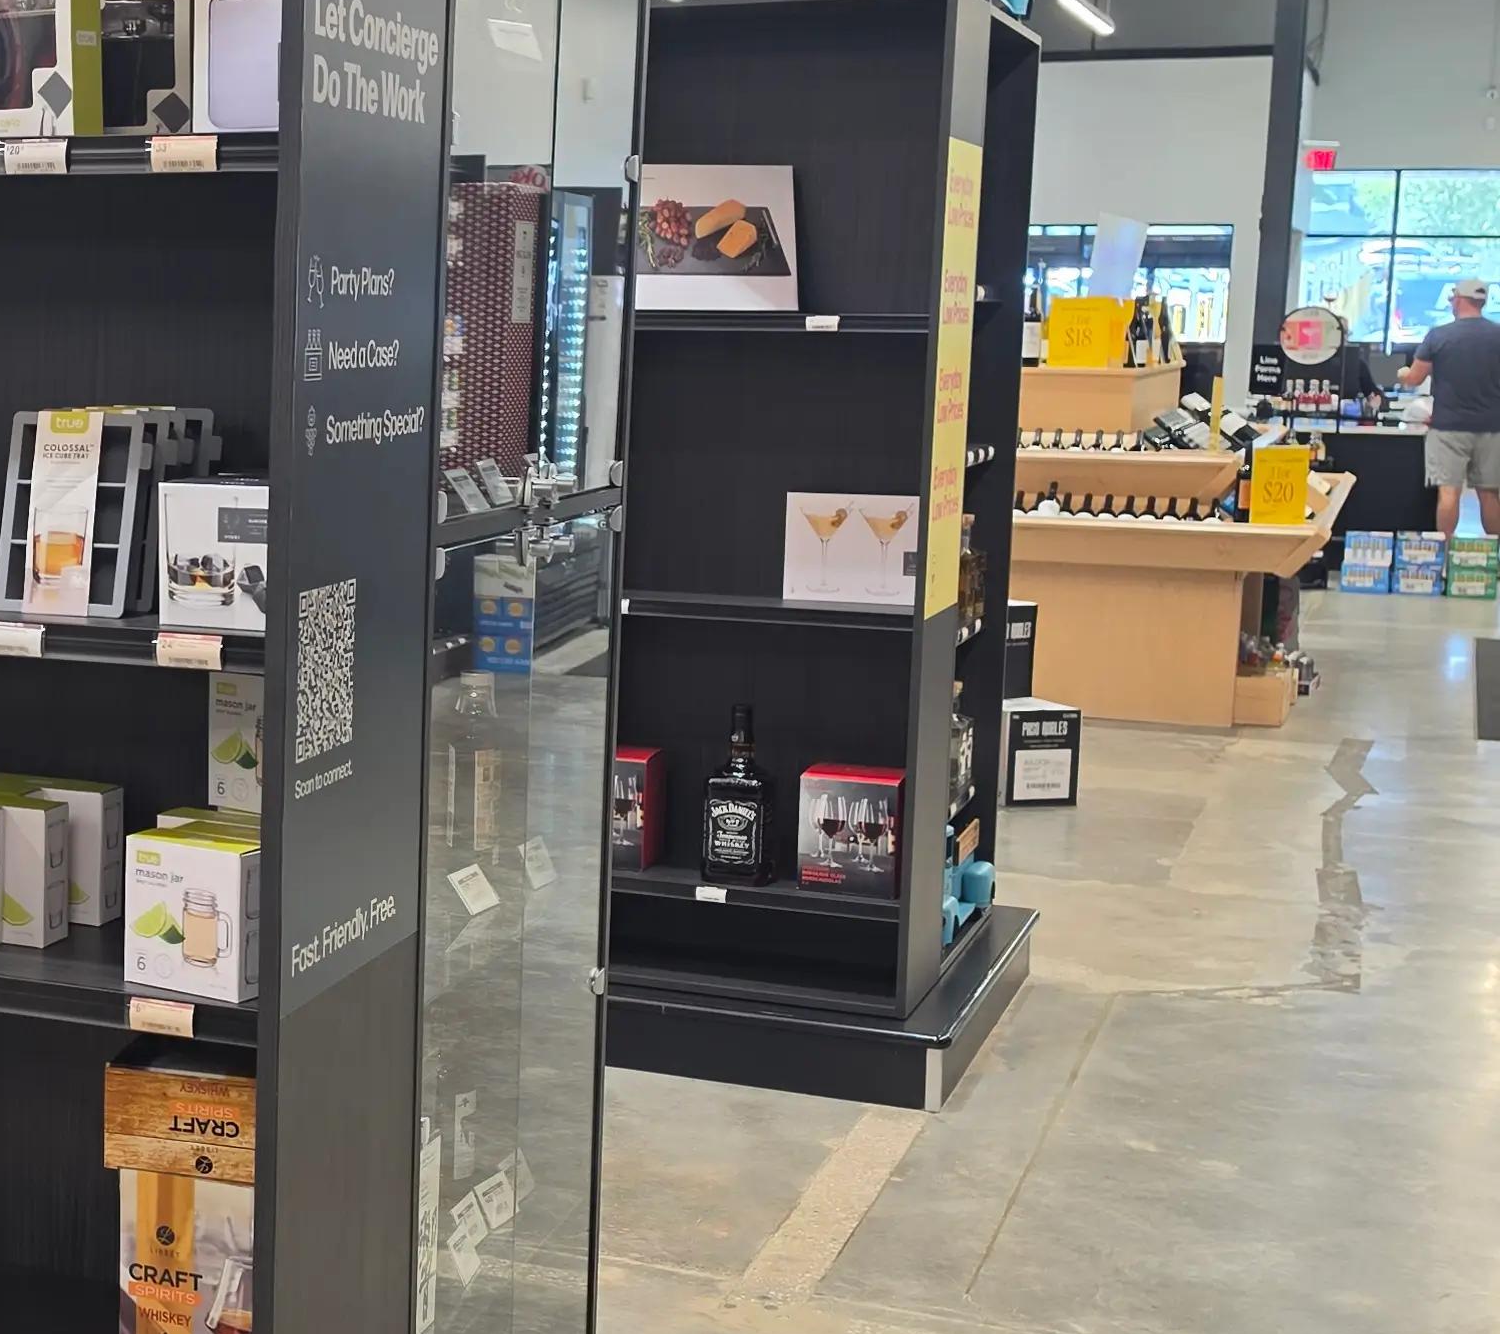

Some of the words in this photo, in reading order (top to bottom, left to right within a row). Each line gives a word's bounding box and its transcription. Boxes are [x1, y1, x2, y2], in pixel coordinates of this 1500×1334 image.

[313, 54, 340, 107] Do
[344, 62, 379, 114] The
[381, 71, 425, 124] Work
[331, 266, 361, 301] Party
[361, 267, 395, 297] Plans?
[329, 340, 357, 370] Need
[359, 349, 366, 367] a
[367, 339, 399, 368] Case?
[56, 417, 85, 429] true
[326, 412, 382, 445] Something
[383, 406, 424, 442] Special?
[1263, 481, 1294, 504] $20
[216, 699, 243, 709] mason
[245, 701, 256, 711] jar
[217, 781, 226, 795] 6
[294, 774, 315, 799] Scan
[315, 772, 323, 790] to
[136, 868, 168, 880] mason
[170, 872, 184, 884] jar
[291, 935, 320, 978] Fast.
[322, 907, 368, 958] Friendly.
[370, 895, 397, 929] Free.
[136, 956, 146, 971] 6
[180, 1082, 230, 1098] WHISKEY
[175, 1102, 234, 1118] SPIRITS
[169, 1115, 240, 1138] CRAFT
[128, 1262, 203, 1292] CRAFT
[135, 1285, 197, 1305] SPIRITS
[139, 1306, 192, 1327] WHISKEY
